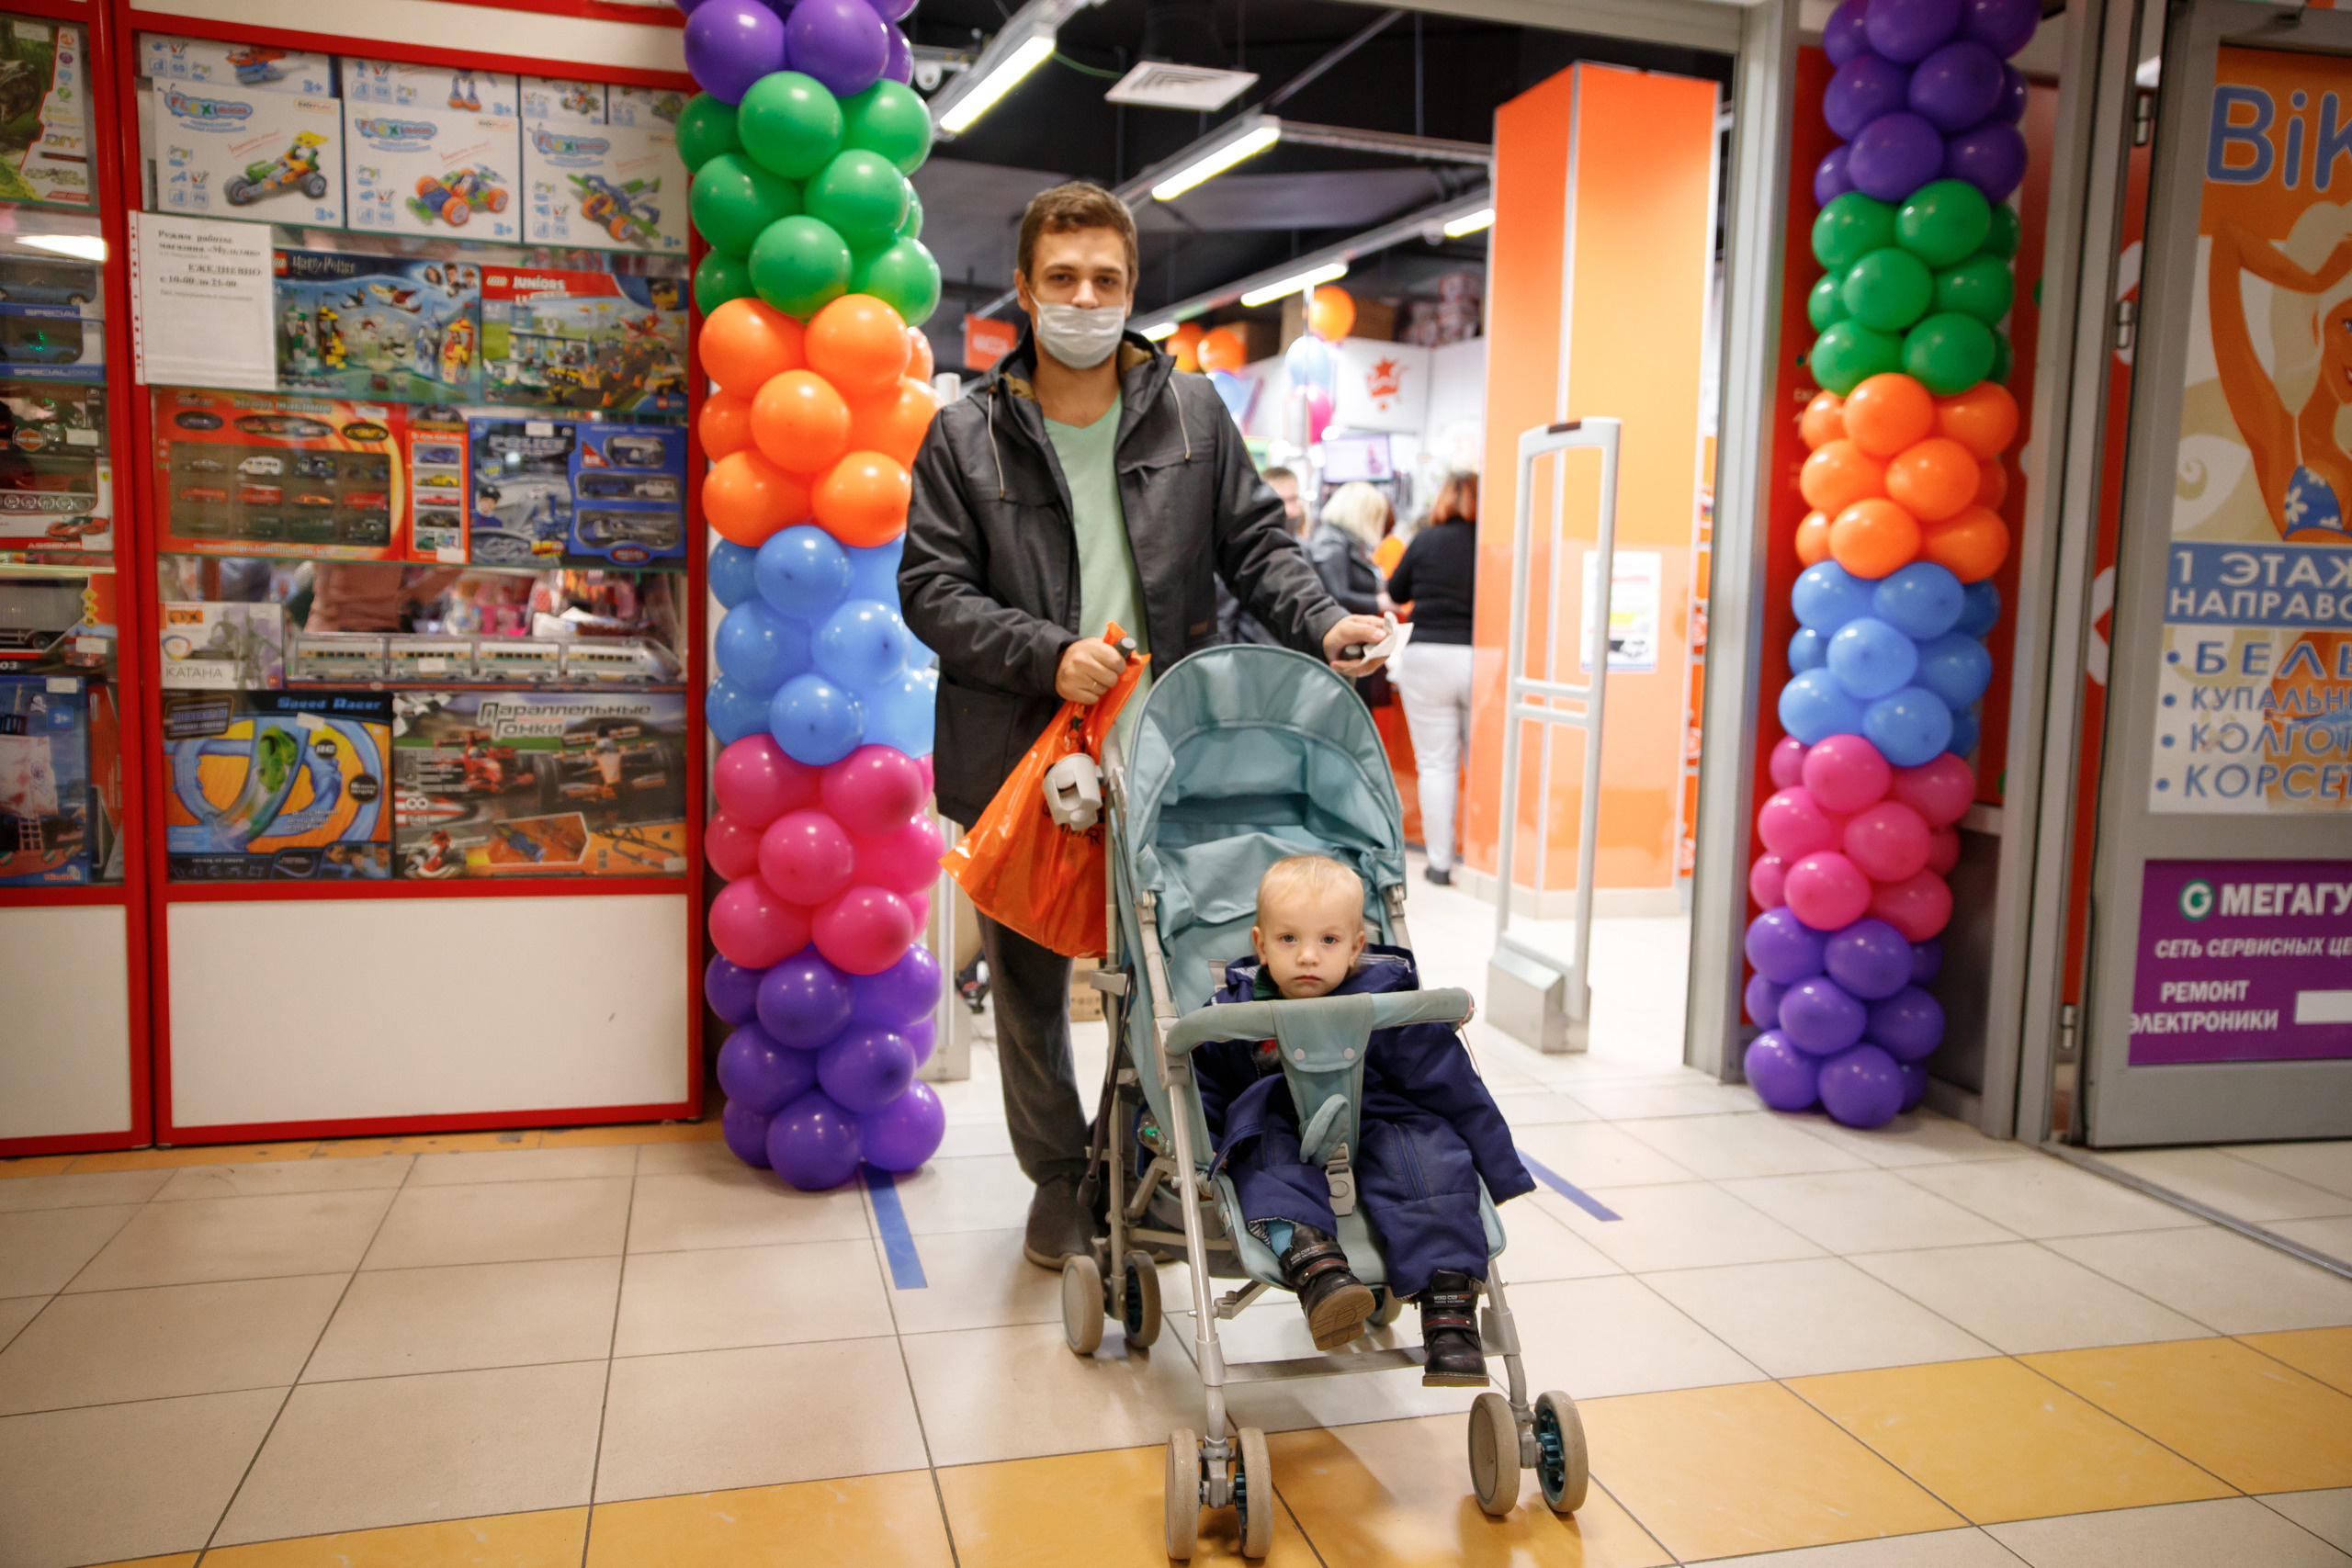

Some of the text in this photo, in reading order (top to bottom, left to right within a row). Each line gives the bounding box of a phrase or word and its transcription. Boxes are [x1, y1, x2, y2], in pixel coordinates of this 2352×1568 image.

[188, 263, 262, 276] ЕЖЕДНЕВНО
[2176, 551, 2194, 584] 1
[165, 666, 222, 679] КАТАНА
[277, 696, 381, 710] Speed Racer
[2191, 686, 2352, 712] КУПАЛЬН
[480, 700, 652, 725] Параллельные
[495, 717, 563, 739] Гонки
[2220, 883, 2352, 916] МЕГАГУ
[2154, 939, 2203, 958] СЕТЬ
[2206, 937, 2325, 957] СЕРВИСНЫХ
[2160, 980, 2250, 1003] РЕМОНТ
[2129, 1010, 2279, 1035] ЭЛЕКТРОНИКИ
